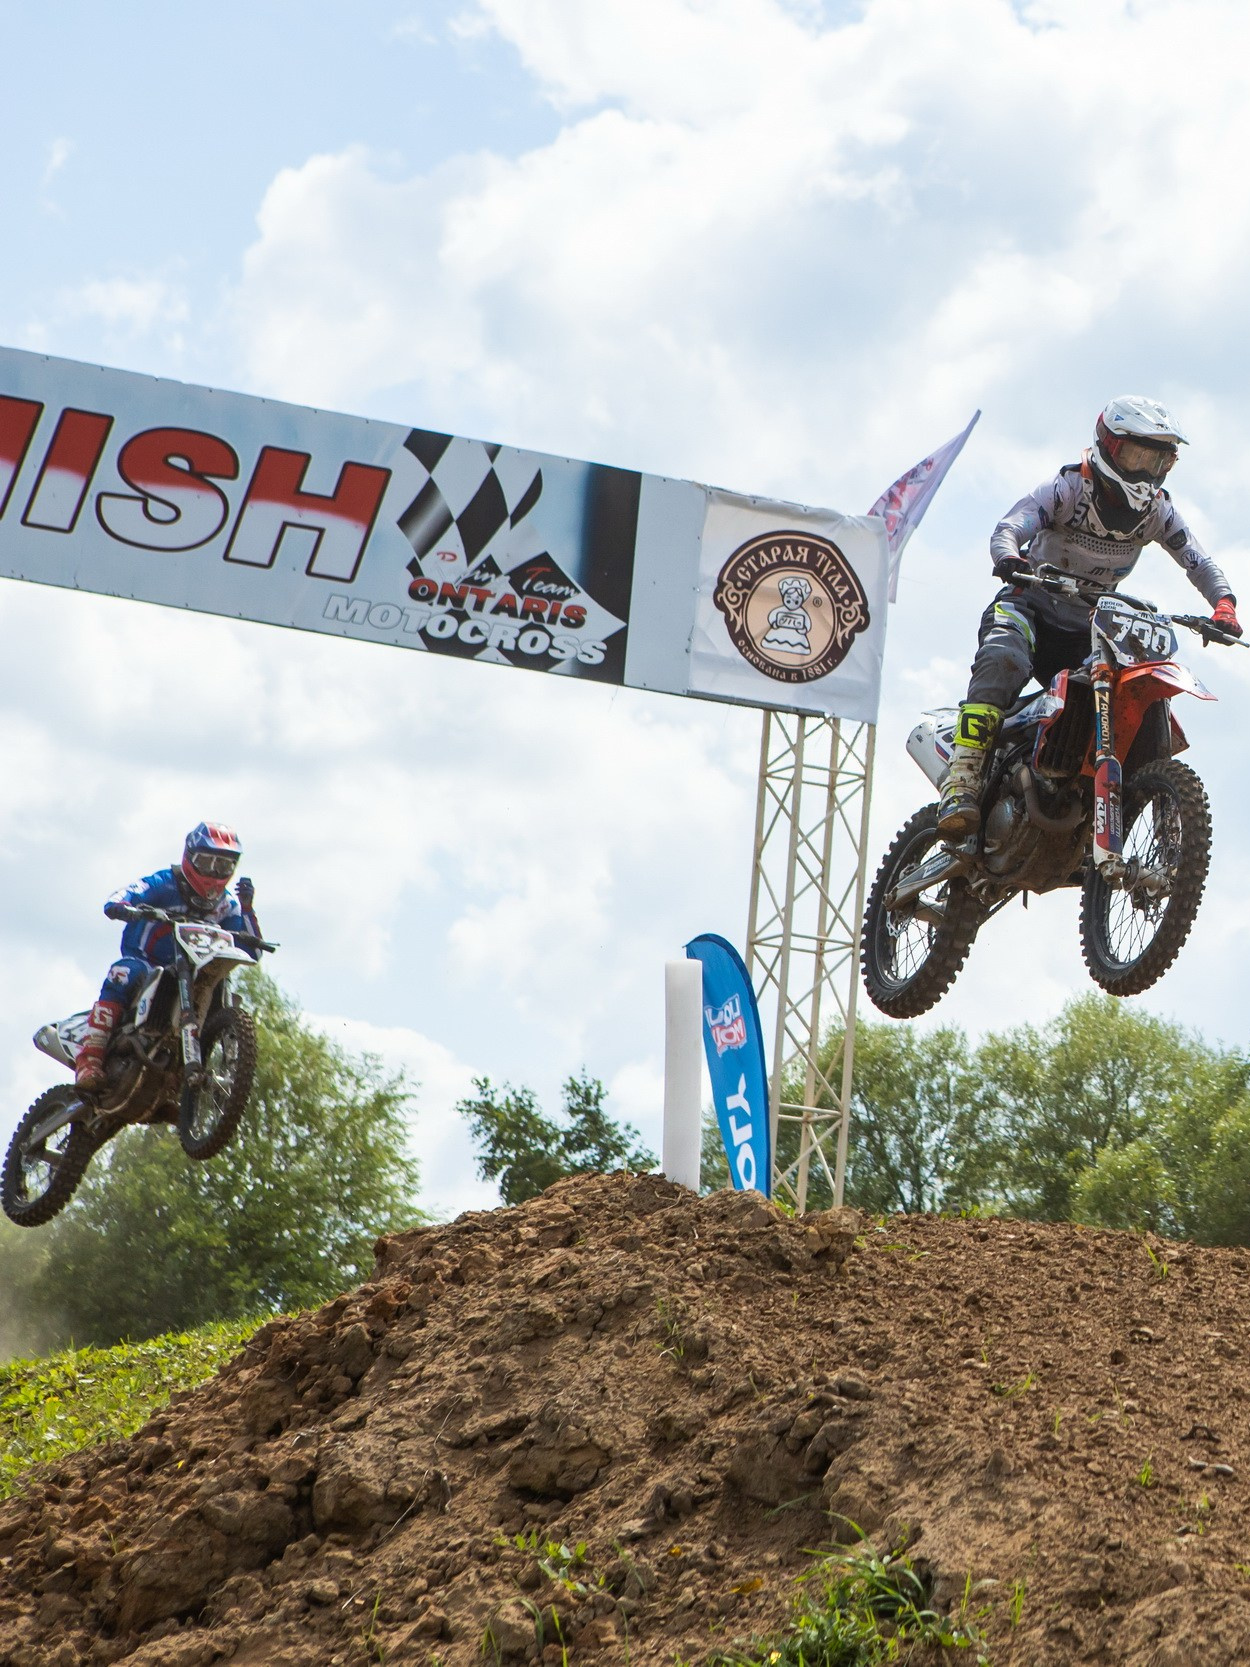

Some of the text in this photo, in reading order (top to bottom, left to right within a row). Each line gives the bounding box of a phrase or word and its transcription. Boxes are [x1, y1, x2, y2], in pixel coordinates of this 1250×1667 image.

[522, 566, 581, 597] Team
[737, 545, 849, 598] СТАРАЯ ТУЛА
[408, 576, 588, 629] ONTARIS
[323, 594, 608, 665] MOTOCROSS
[802, 662, 827, 680] 1881
[1096, 796, 1107, 834] KTM
